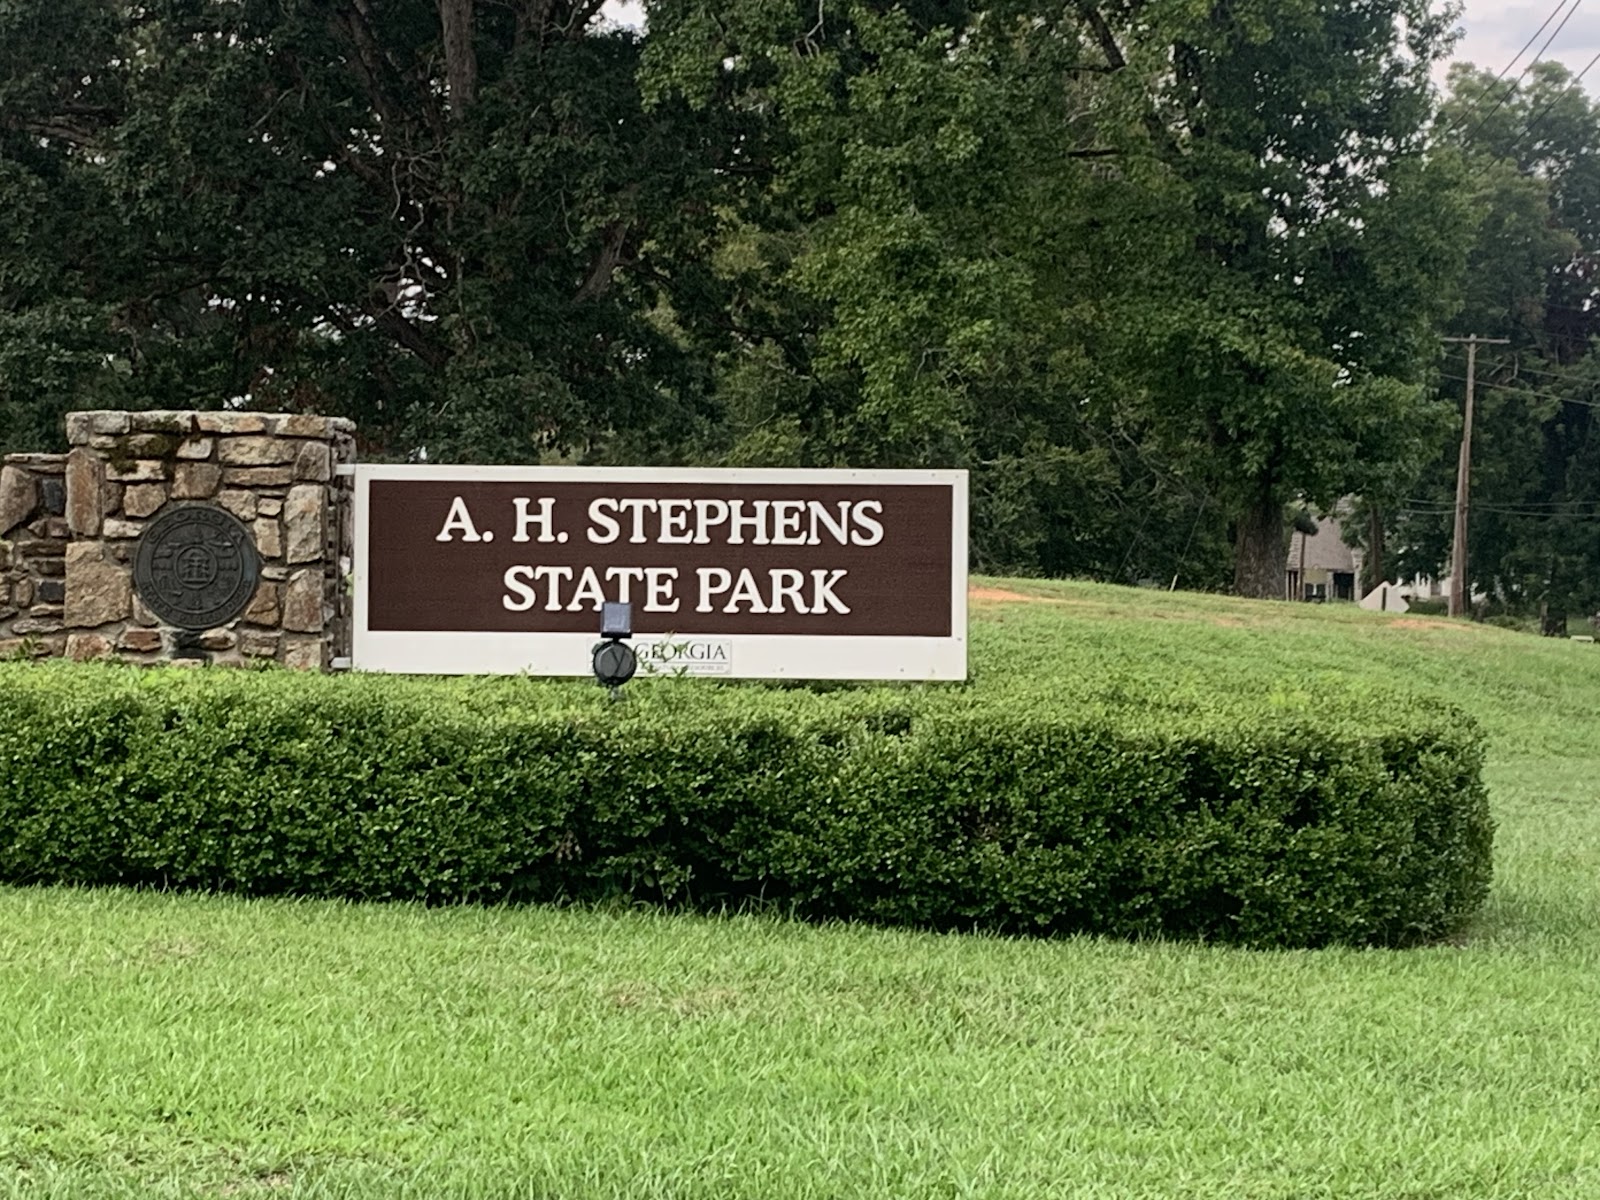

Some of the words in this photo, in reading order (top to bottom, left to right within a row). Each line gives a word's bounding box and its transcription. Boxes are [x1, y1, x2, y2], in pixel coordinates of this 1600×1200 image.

[148, 510, 245, 546] GEORGIA
[435, 496, 493, 542] A.
[512, 497, 568, 542] H.
[586, 497, 884, 546] STEPHENS
[502, 565, 679, 614] STATE
[695, 567, 851, 615] PARK
